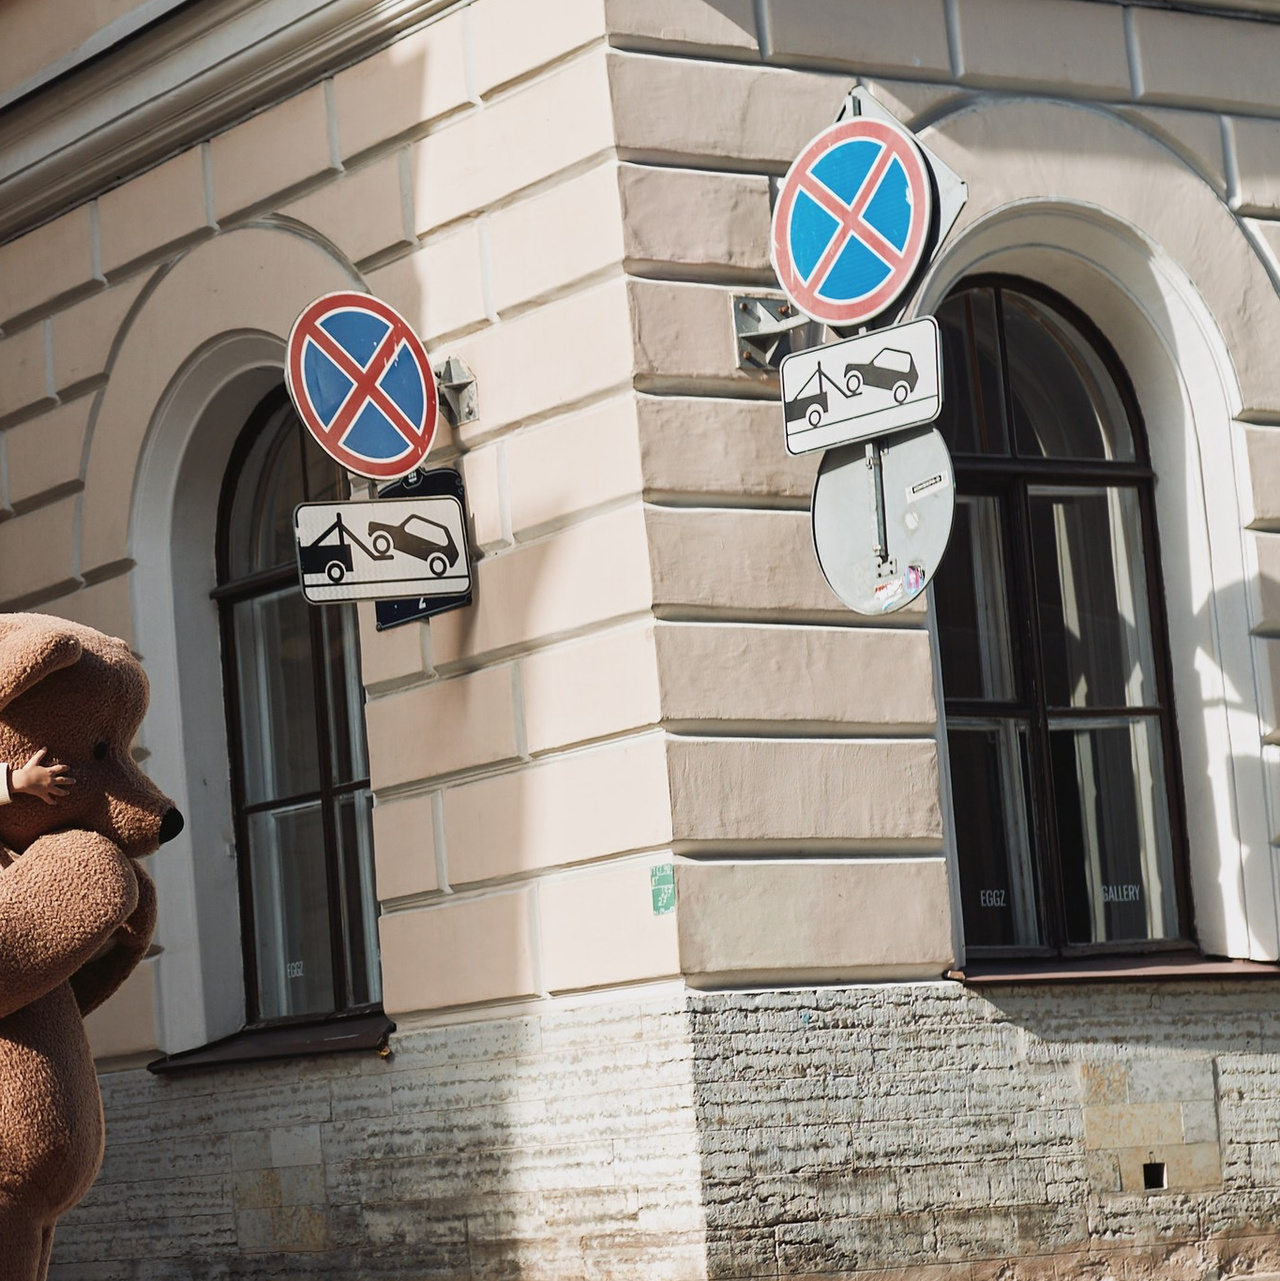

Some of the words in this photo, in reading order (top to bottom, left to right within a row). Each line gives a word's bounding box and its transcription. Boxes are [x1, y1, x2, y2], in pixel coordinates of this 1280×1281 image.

[980, 889, 1006, 907] EGGZ
[1102, 884, 1140, 902] GALLERY
[287, 961, 304, 978] EGGZ
